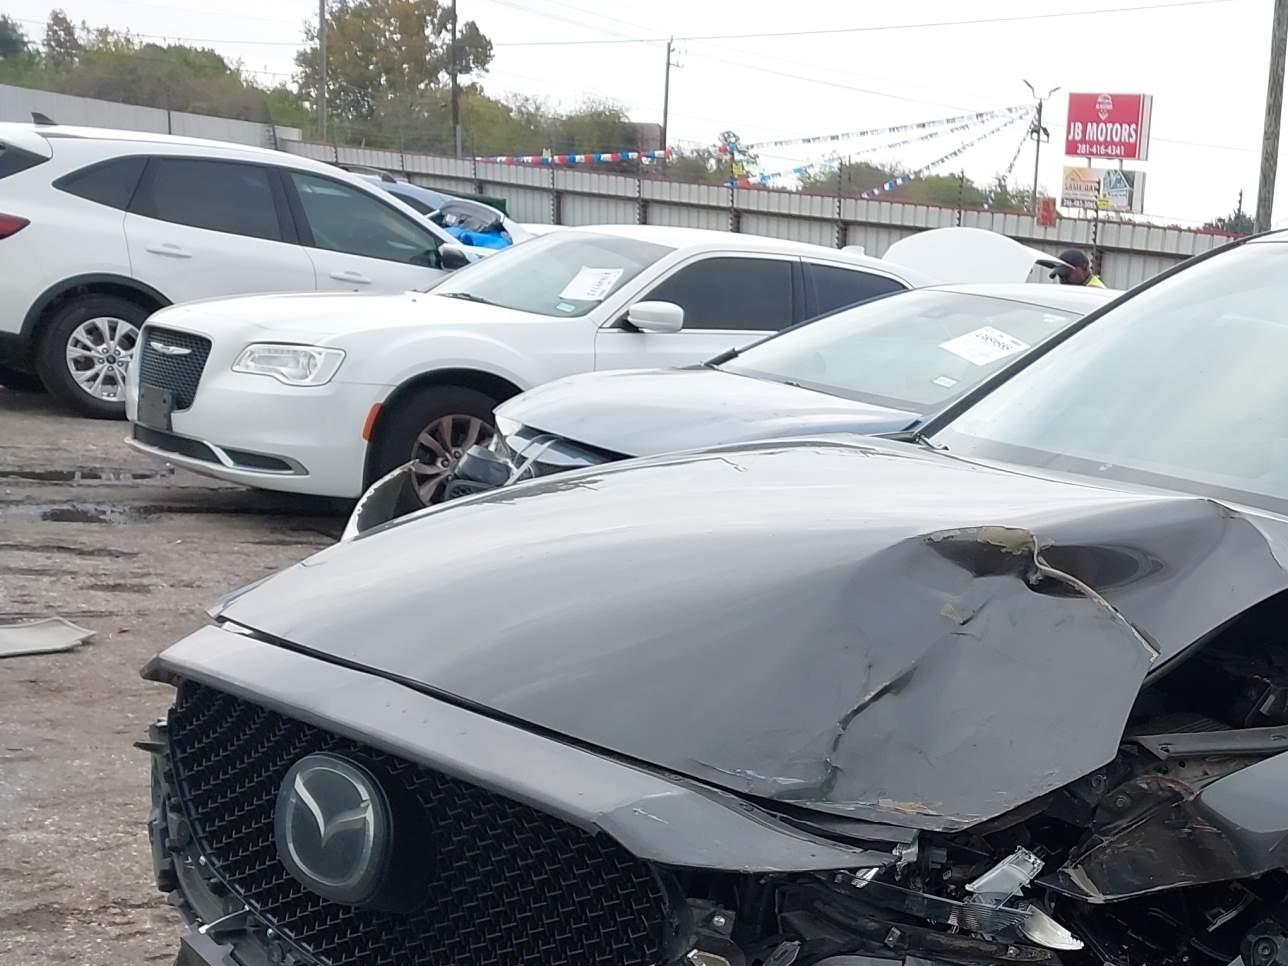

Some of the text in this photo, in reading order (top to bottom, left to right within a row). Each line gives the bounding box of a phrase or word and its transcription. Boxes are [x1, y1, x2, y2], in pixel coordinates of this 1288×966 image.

[1068, 122, 1137, 143] JB MOTORS
[1077, 144, 1125, 156] 281-416-4341
